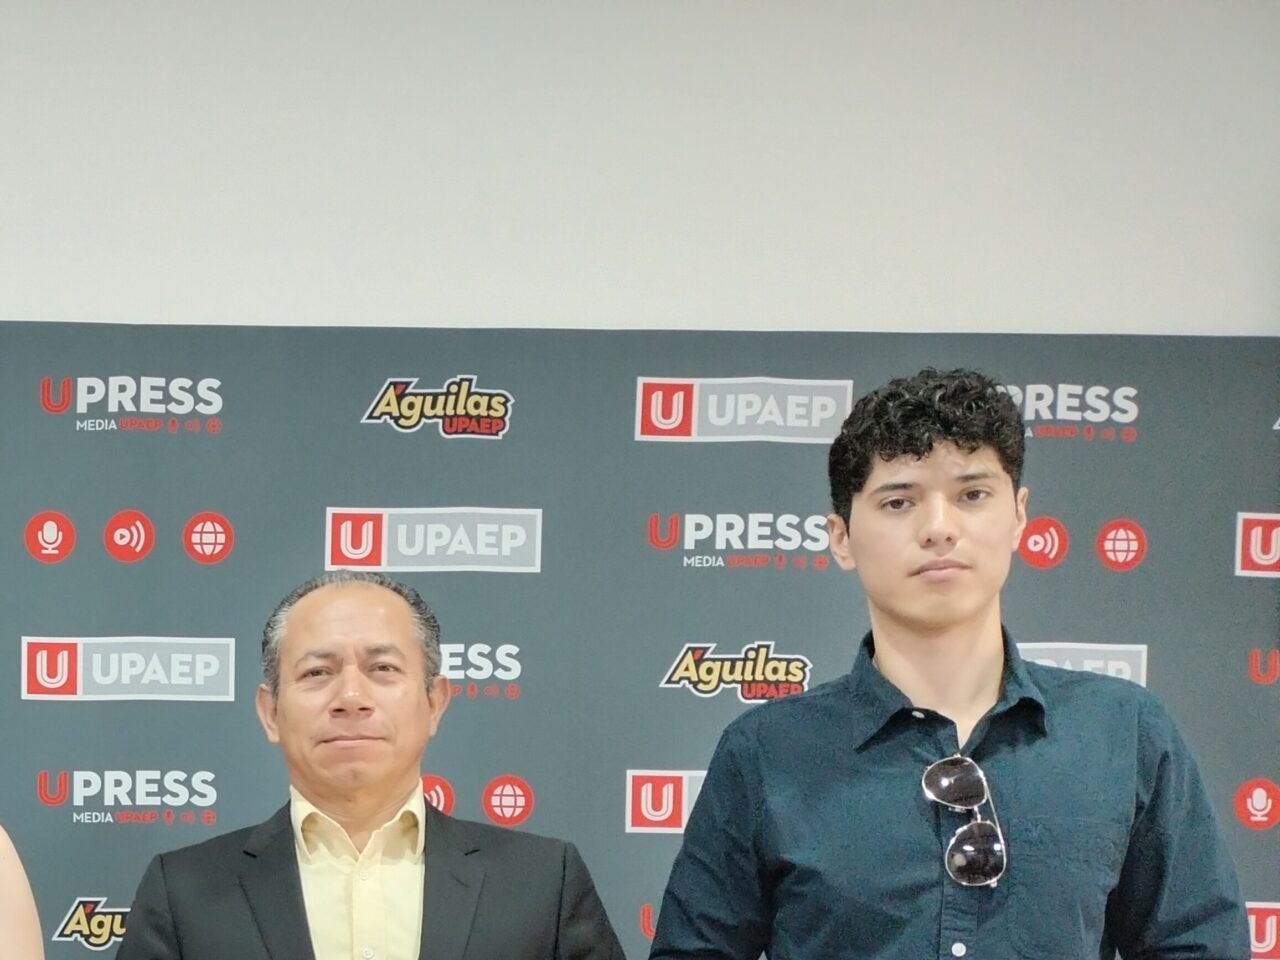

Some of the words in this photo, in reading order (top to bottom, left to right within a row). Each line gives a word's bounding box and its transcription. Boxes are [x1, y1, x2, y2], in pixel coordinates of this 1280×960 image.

[40, 375, 223, 415] UPRESS
[373, 377, 506, 425] Águilas
[651, 391, 682, 429] U
[708, 395, 836, 427] UPAEP
[76, 419, 117, 431] MEDIA
[443, 416, 505, 435] UPAEP
[340, 520, 372, 559] U
[397, 524, 527, 557] UPAEP
[648, 512, 829, 551] UPRESS
[683, 556, 724, 567] MEDIA
[37, 649, 68, 688] U
[92, 653, 219, 685] UPAEP
[438, 643, 522, 680] ESS
[670, 646, 804, 686] Águilas
[37, 769, 217, 806] UPRESS
[73, 812, 113, 823] MEDIA
